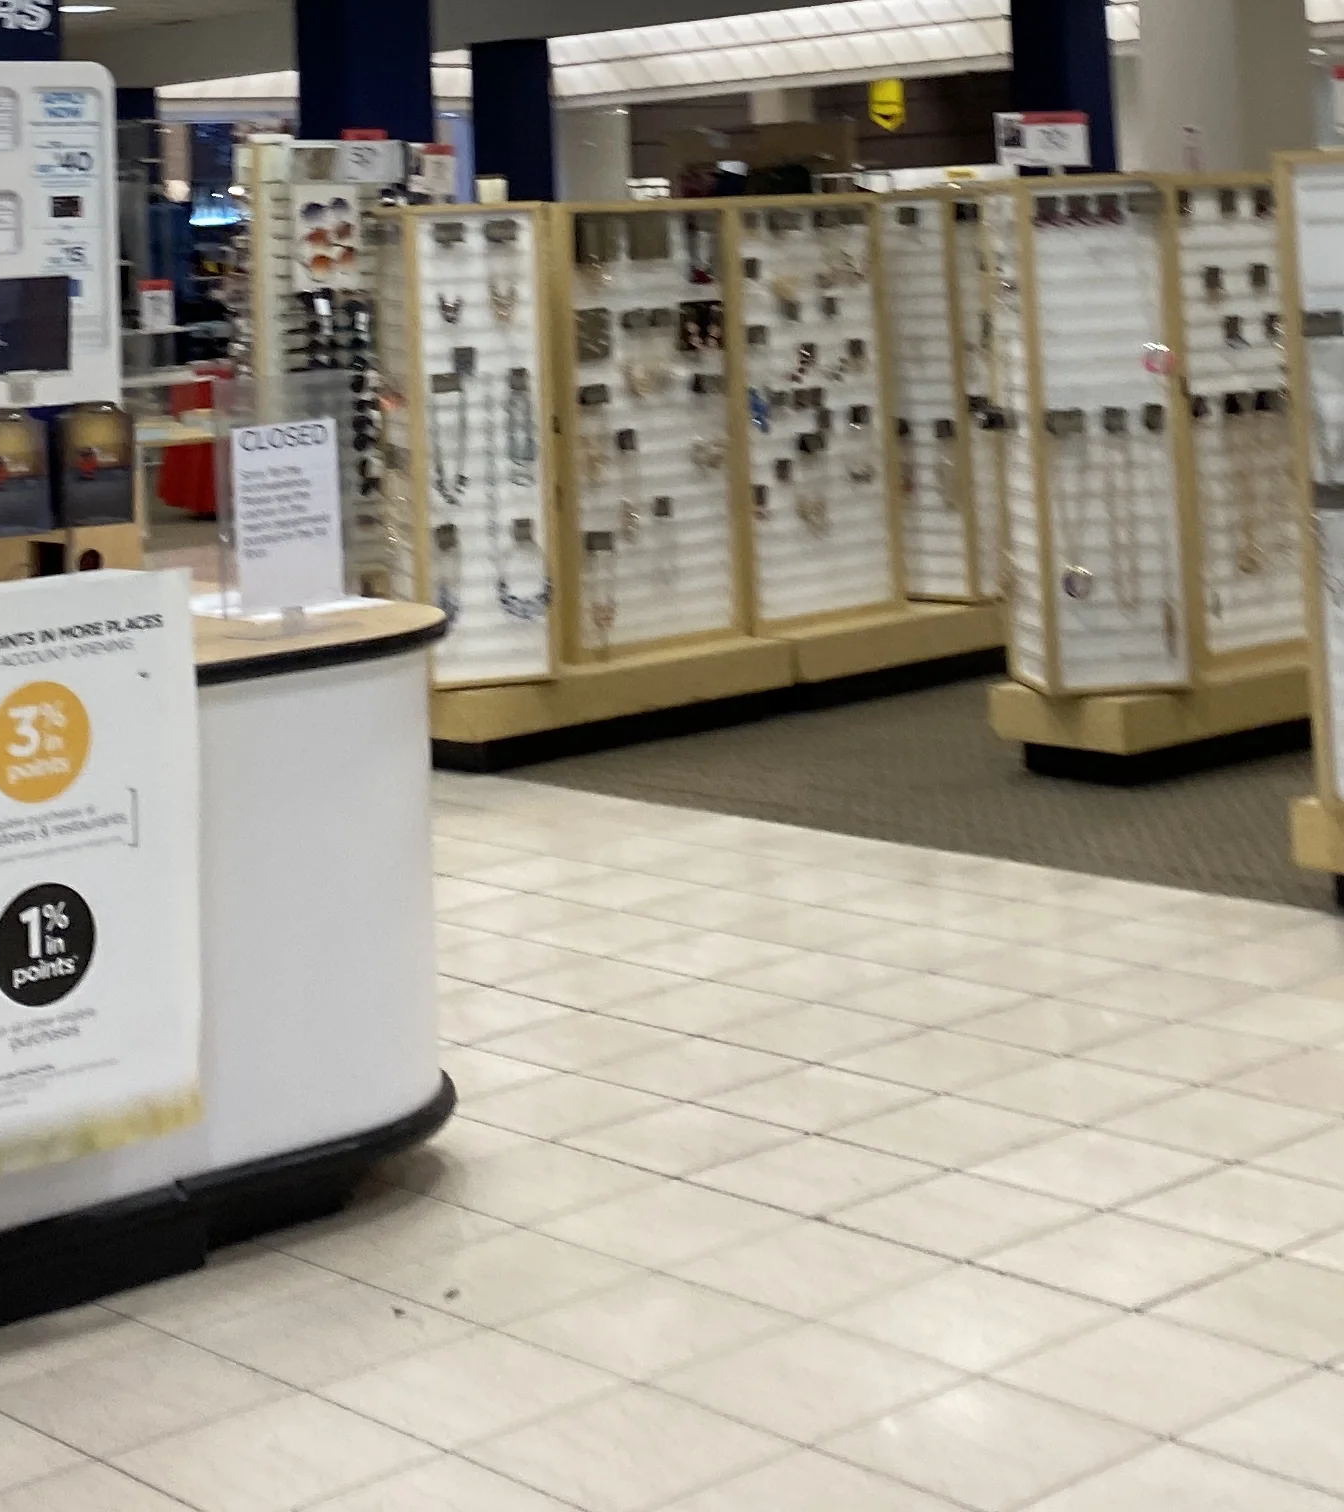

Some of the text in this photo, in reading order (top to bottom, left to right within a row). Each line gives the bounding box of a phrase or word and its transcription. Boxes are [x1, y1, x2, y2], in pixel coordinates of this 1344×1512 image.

[239, 424, 328, 451] CLOSED
[38, 629, 56, 643] IN
[58, 621, 104, 639] MORE
[105, 613, 165, 634] PLACES
[18, 900, 70, 959] 1%
[44, 932, 66, 955] in
[11, 959, 77, 990] points
